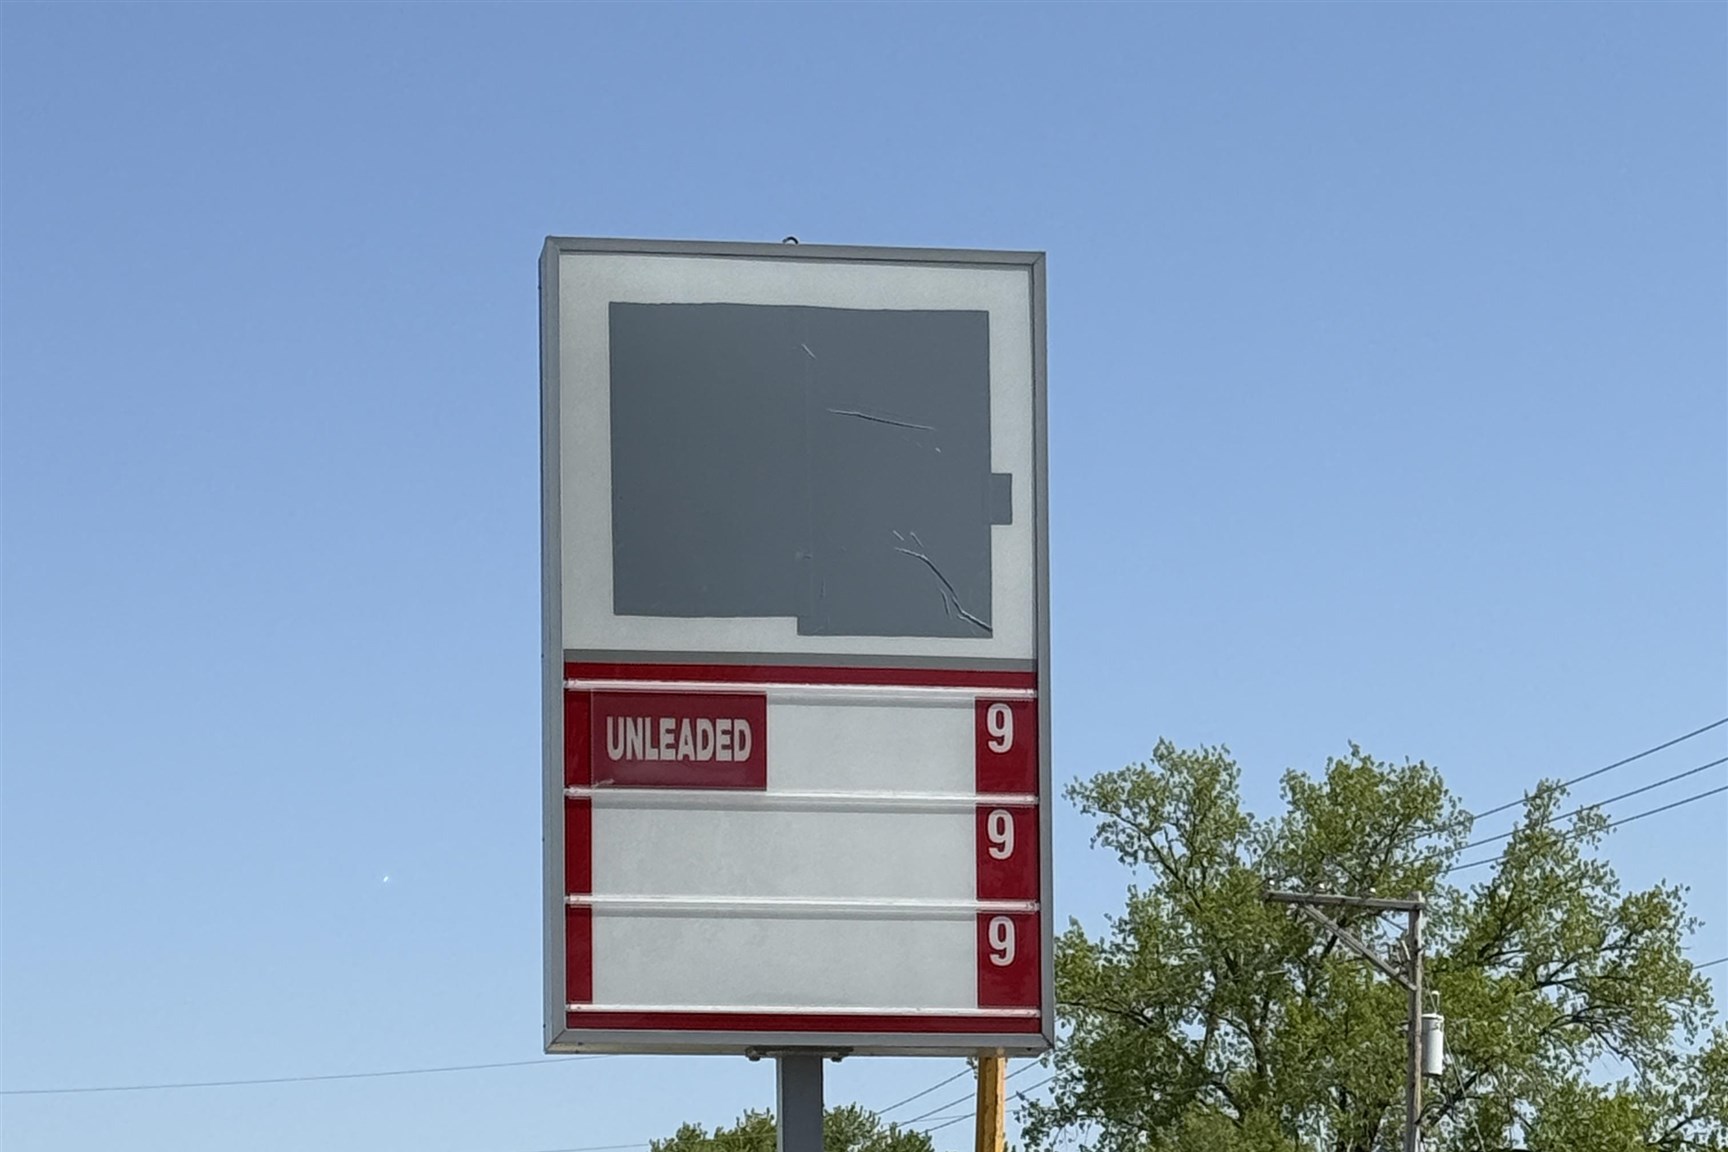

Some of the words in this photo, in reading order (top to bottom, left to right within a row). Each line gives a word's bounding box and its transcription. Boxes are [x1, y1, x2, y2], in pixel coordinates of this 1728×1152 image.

[606, 716, 752, 762] UNLEADED
[987, 703, 1015, 753] 9
[987, 809, 1015, 860] 9
[988, 916, 1016, 967] 9
